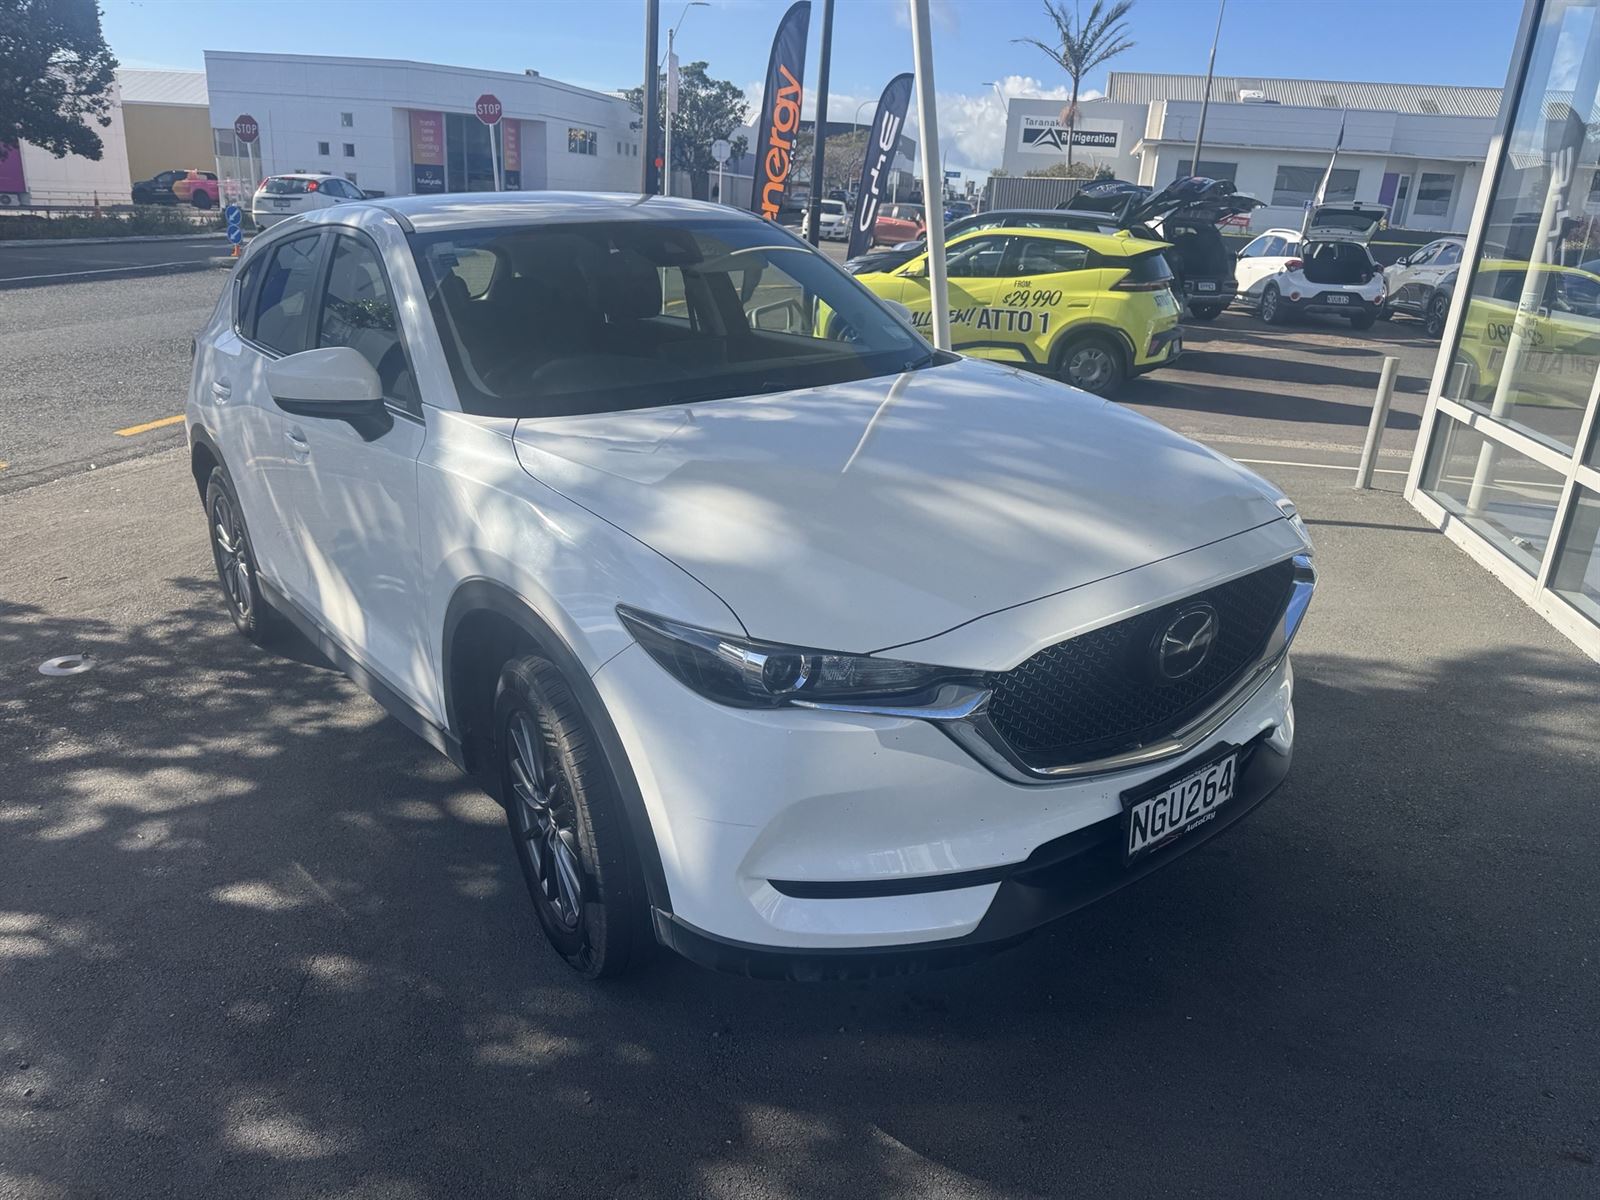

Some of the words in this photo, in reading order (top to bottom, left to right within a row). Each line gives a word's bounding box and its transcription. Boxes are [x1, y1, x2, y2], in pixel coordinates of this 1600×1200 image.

[477, 103, 501, 115] STOP
[236, 123, 257, 134] STOP
[760, 63, 803, 222] nergy
[1002, 289, 1063, 309] $29,990
[948, 307, 977, 327] EW!
[976, 308, 1032, 333] ATTO
[1038, 311, 1050, 334] 1
[1129, 759, 1233, 850] NGU264
